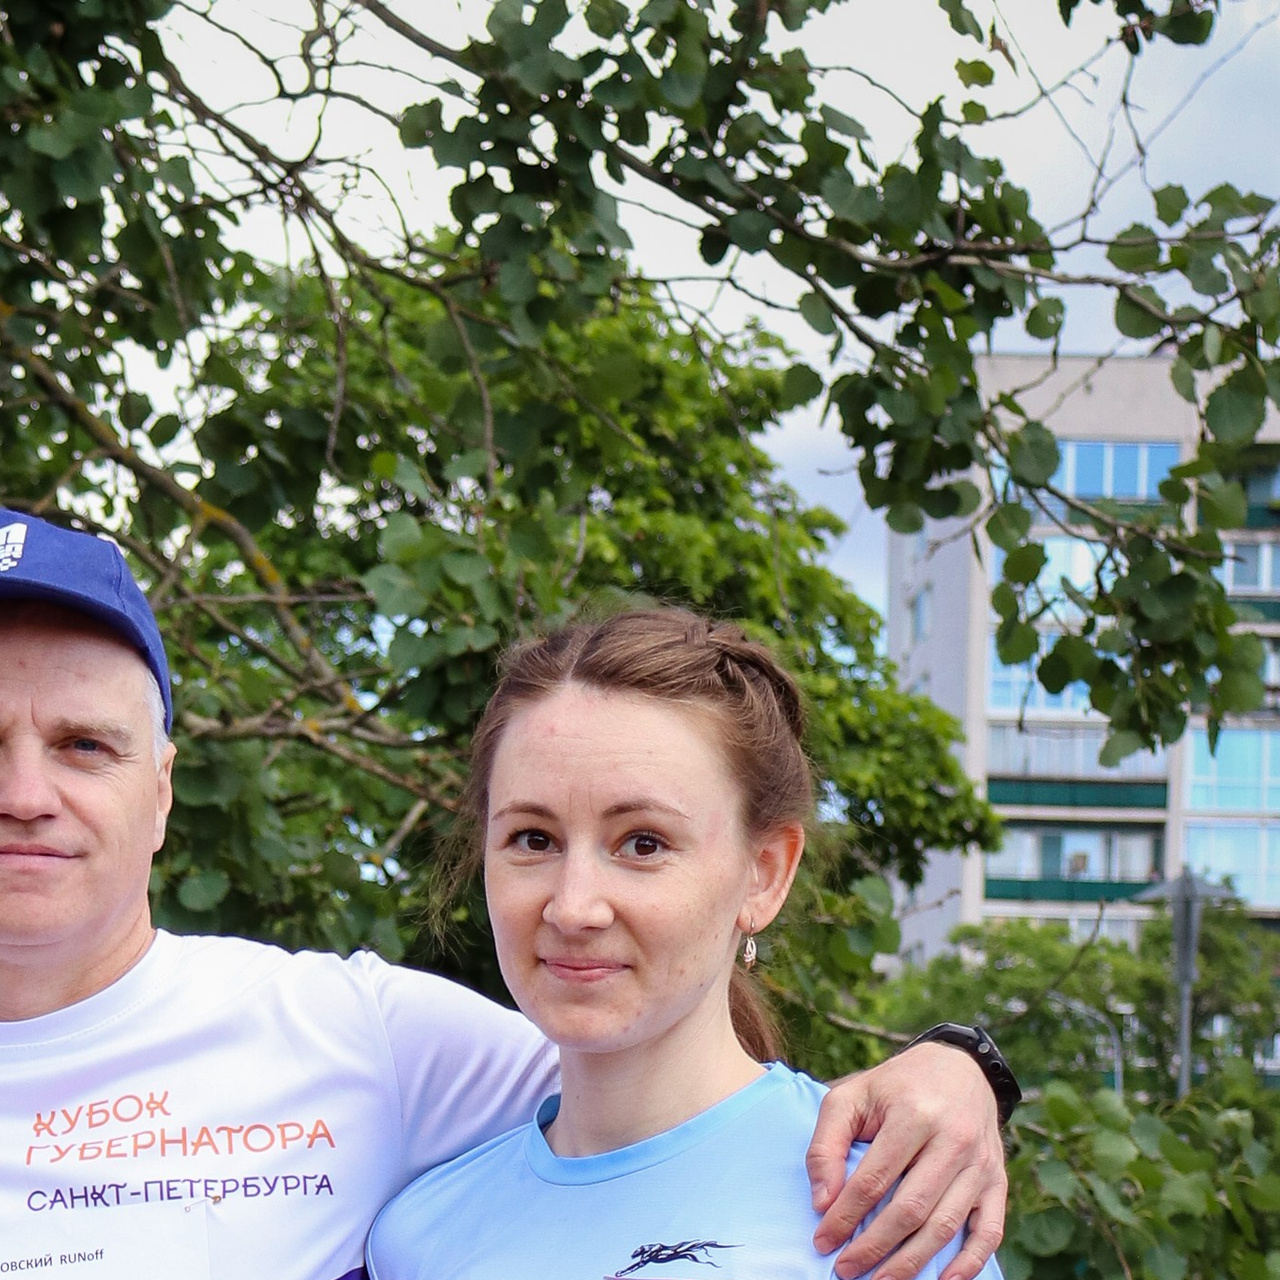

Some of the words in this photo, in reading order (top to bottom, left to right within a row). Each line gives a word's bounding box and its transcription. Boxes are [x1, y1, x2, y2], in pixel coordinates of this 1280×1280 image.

[32, 1090, 172, 1138] КУБОК
[25, 1119, 336, 1166] ГУБЕРНАТОРА
[26, 1174, 334, 1212] САНКТ-ПЕТЕРБУРГА
[59, 1248, 105, 1266] RUNoff
